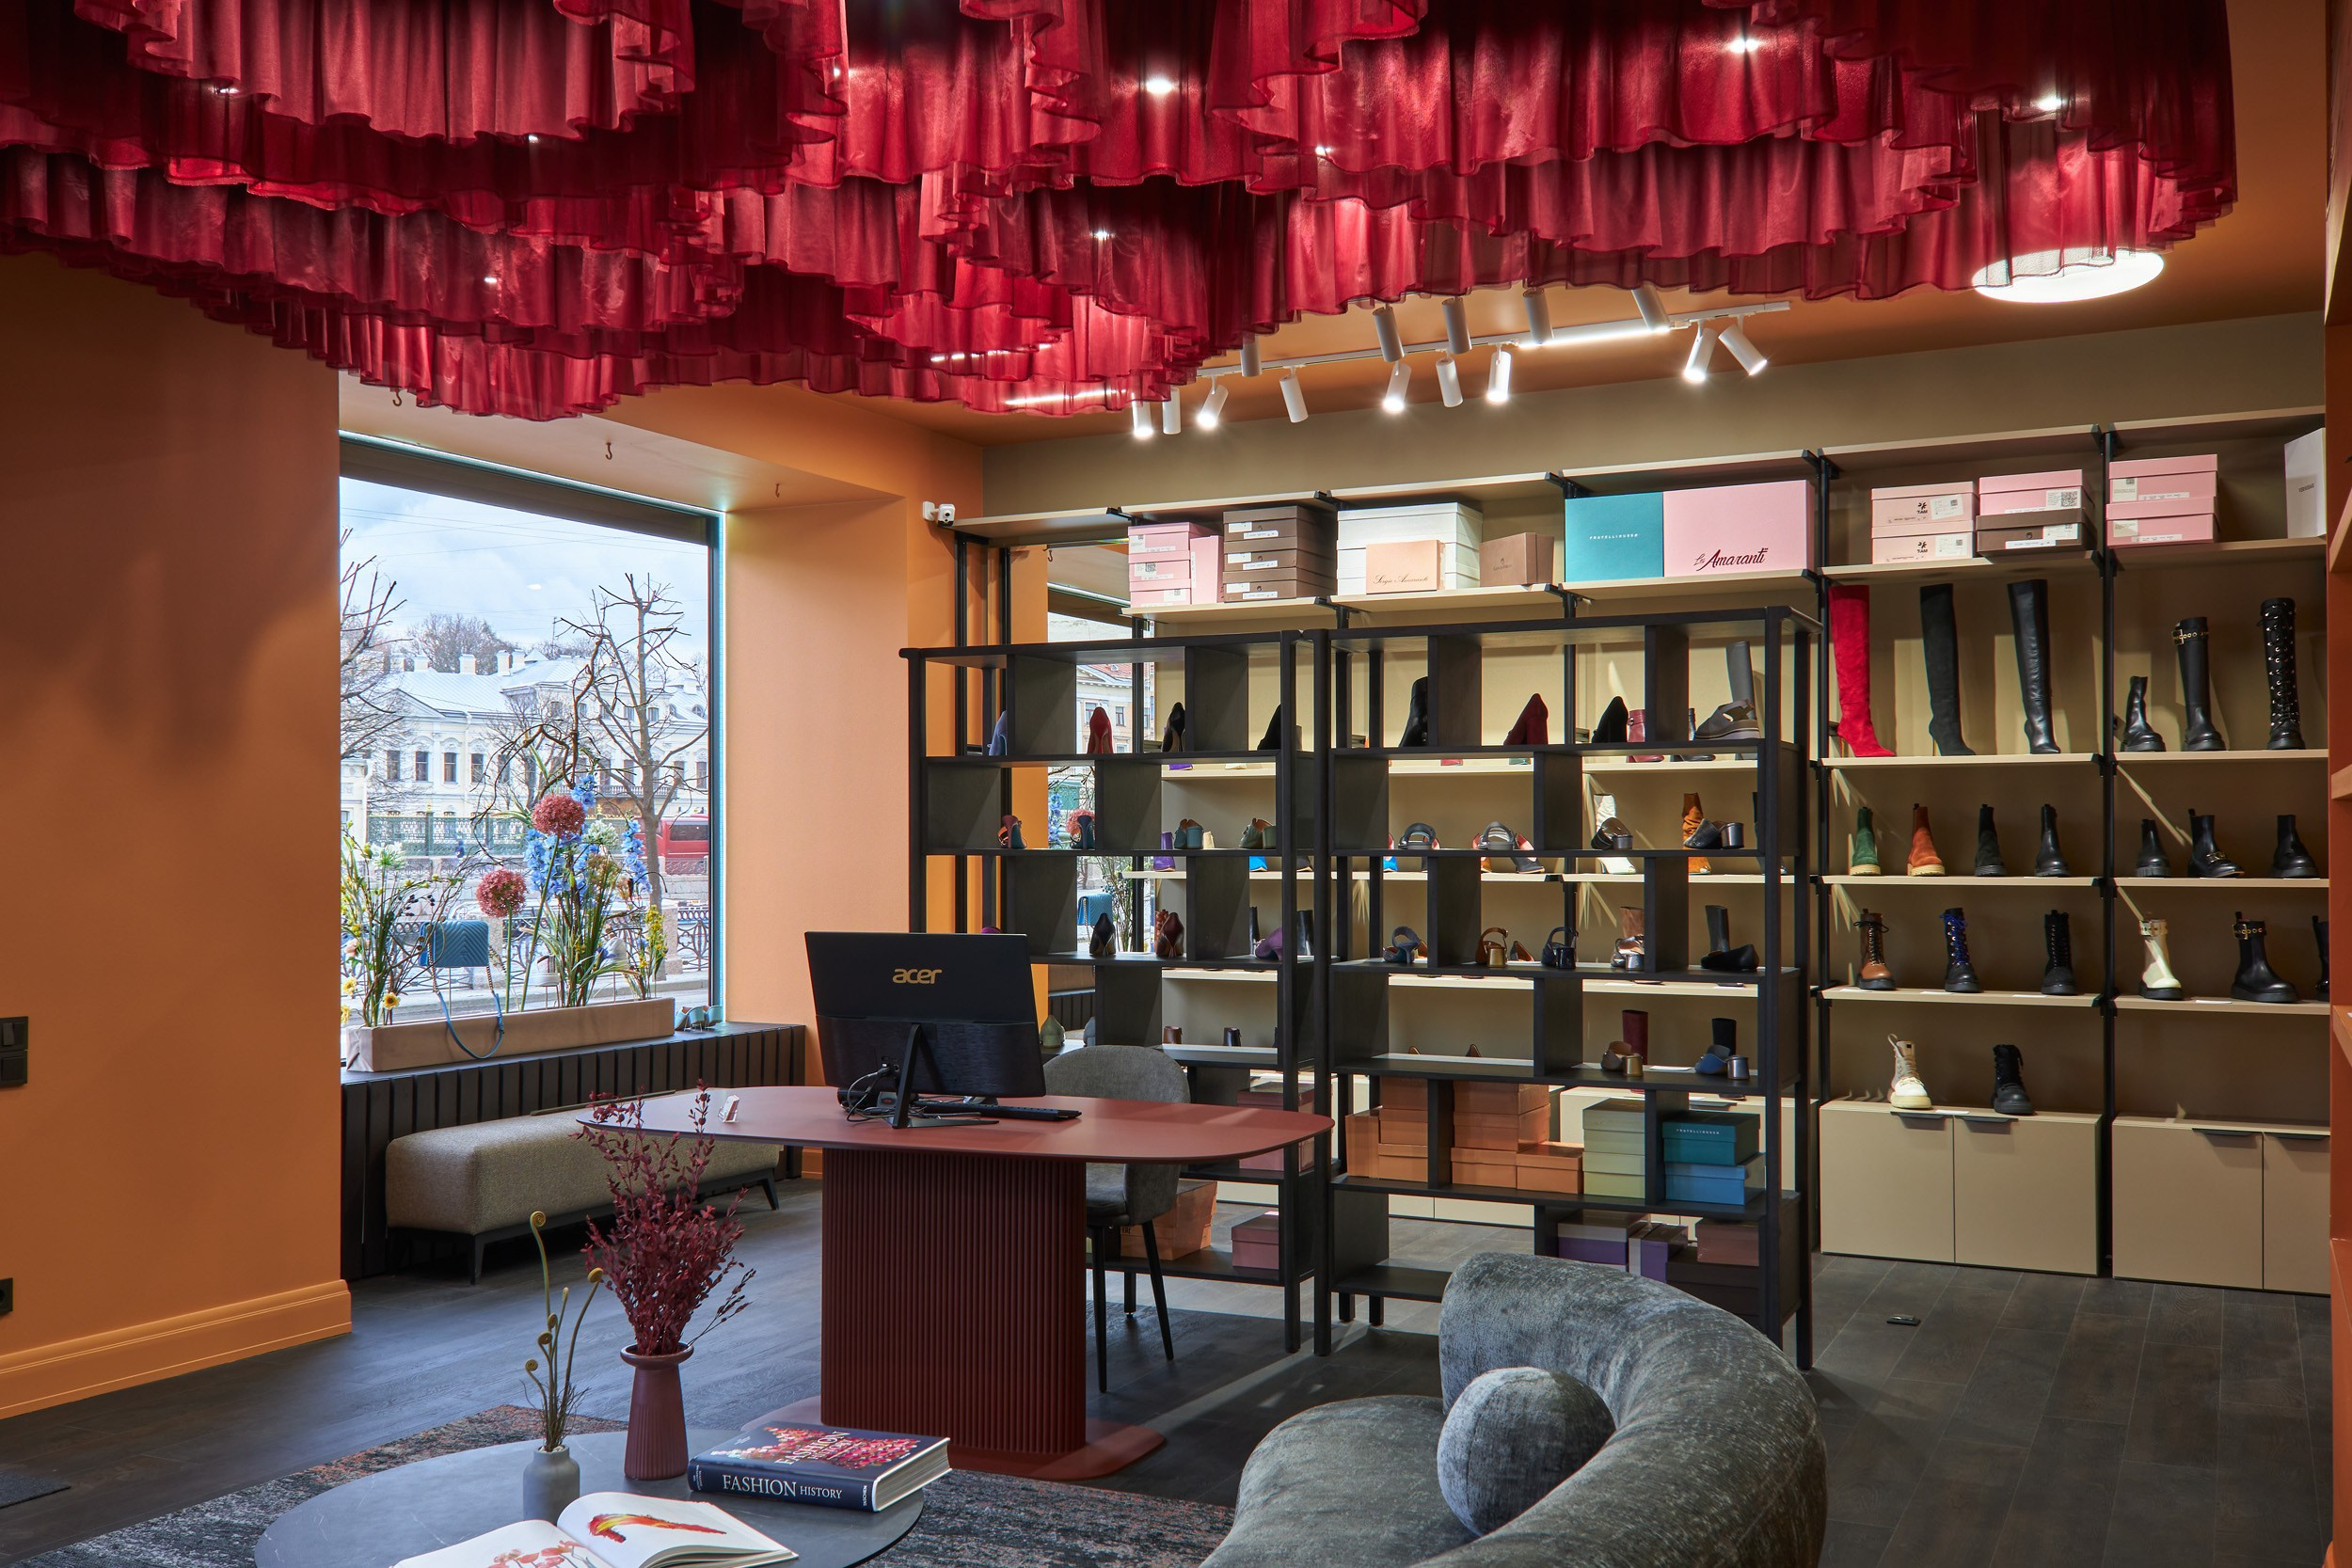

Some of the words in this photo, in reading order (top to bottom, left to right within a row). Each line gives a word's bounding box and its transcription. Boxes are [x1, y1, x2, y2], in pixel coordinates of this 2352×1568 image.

[892, 968, 943, 984] acer
[774, 1431, 850, 1465] FASHION
[722, 1474, 797, 1497] FASHION
[800, 1485, 843, 1499] HISTORY
